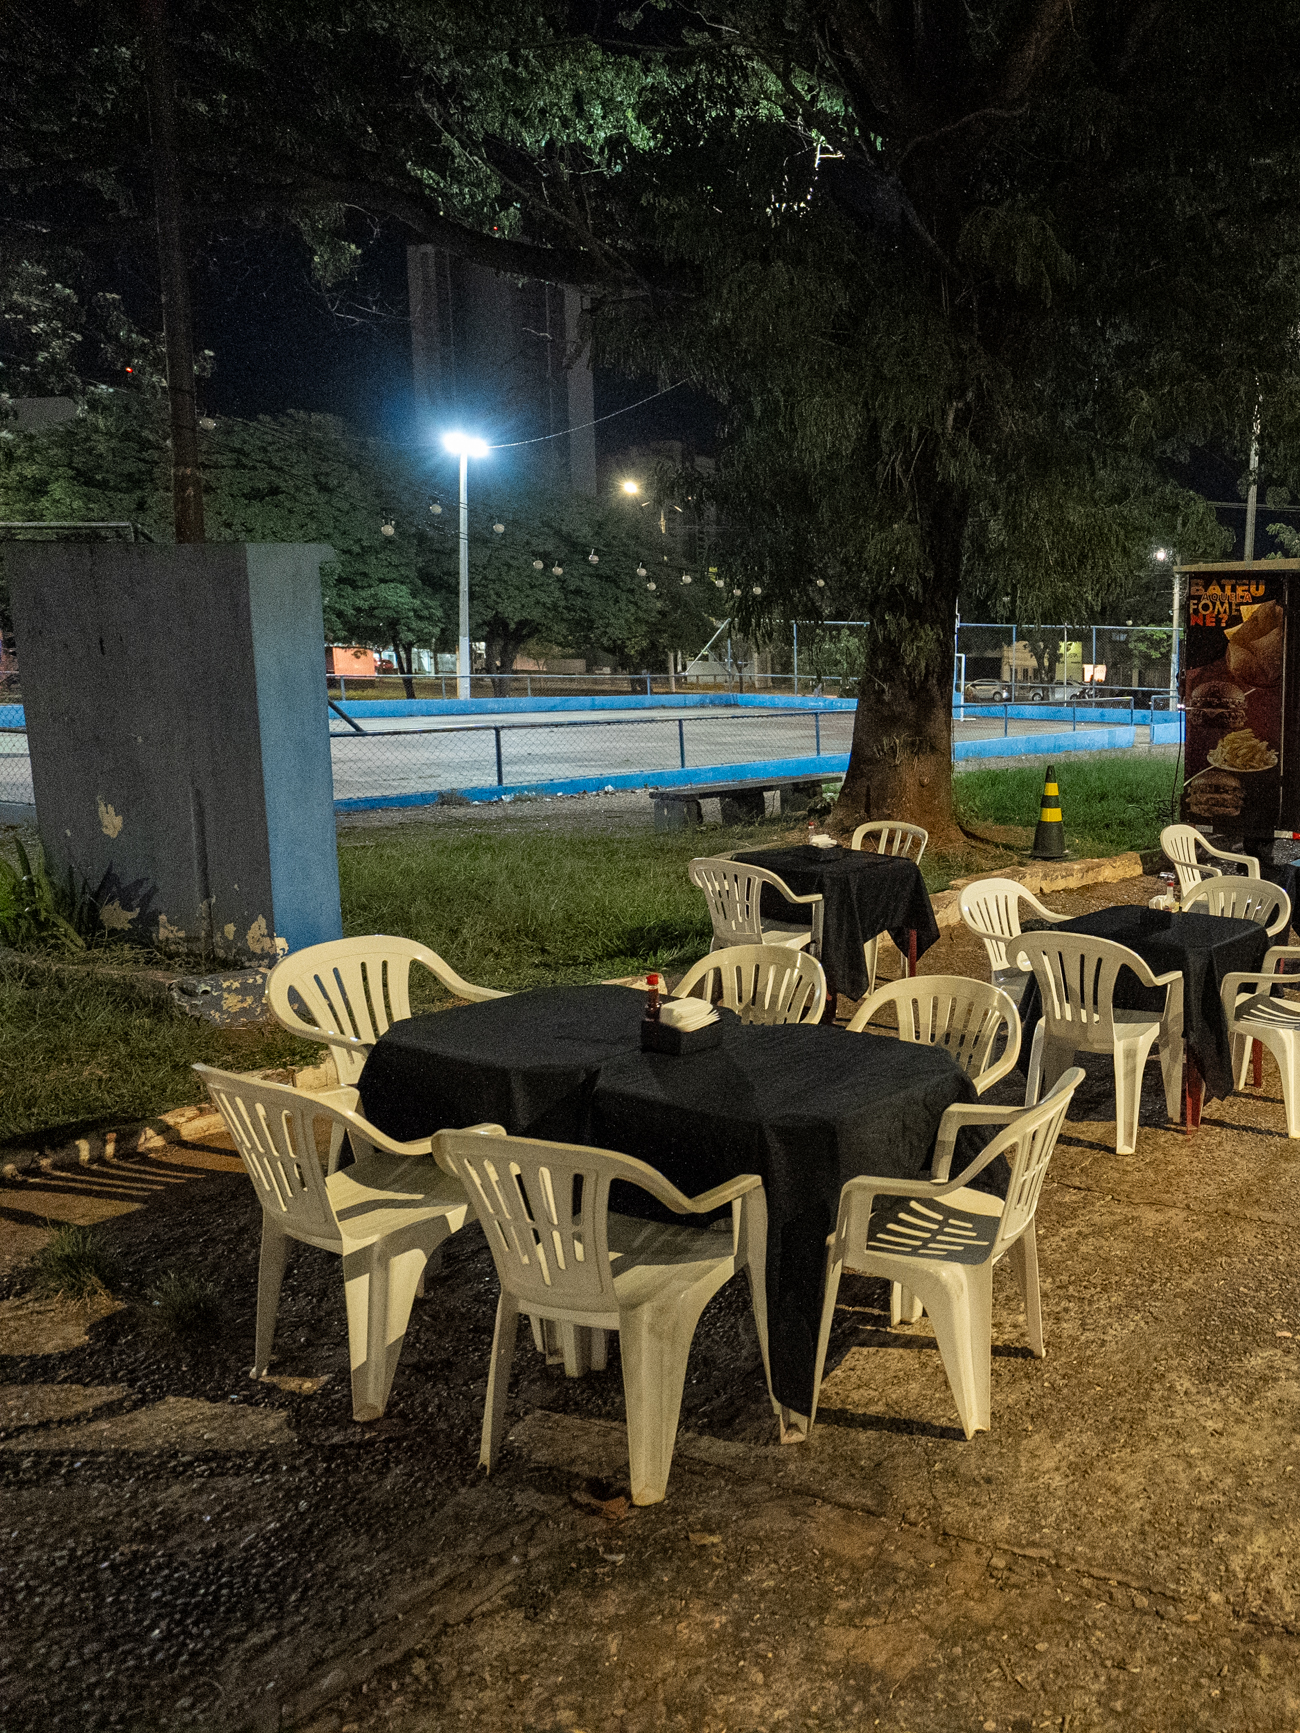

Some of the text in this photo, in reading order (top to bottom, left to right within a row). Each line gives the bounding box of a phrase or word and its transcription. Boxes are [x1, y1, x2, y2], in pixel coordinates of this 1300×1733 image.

[1190, 579, 1265, 597] BATEU
[1201, 592, 1252, 602] AQUELA
[1190, 600, 1240, 615] FOME
